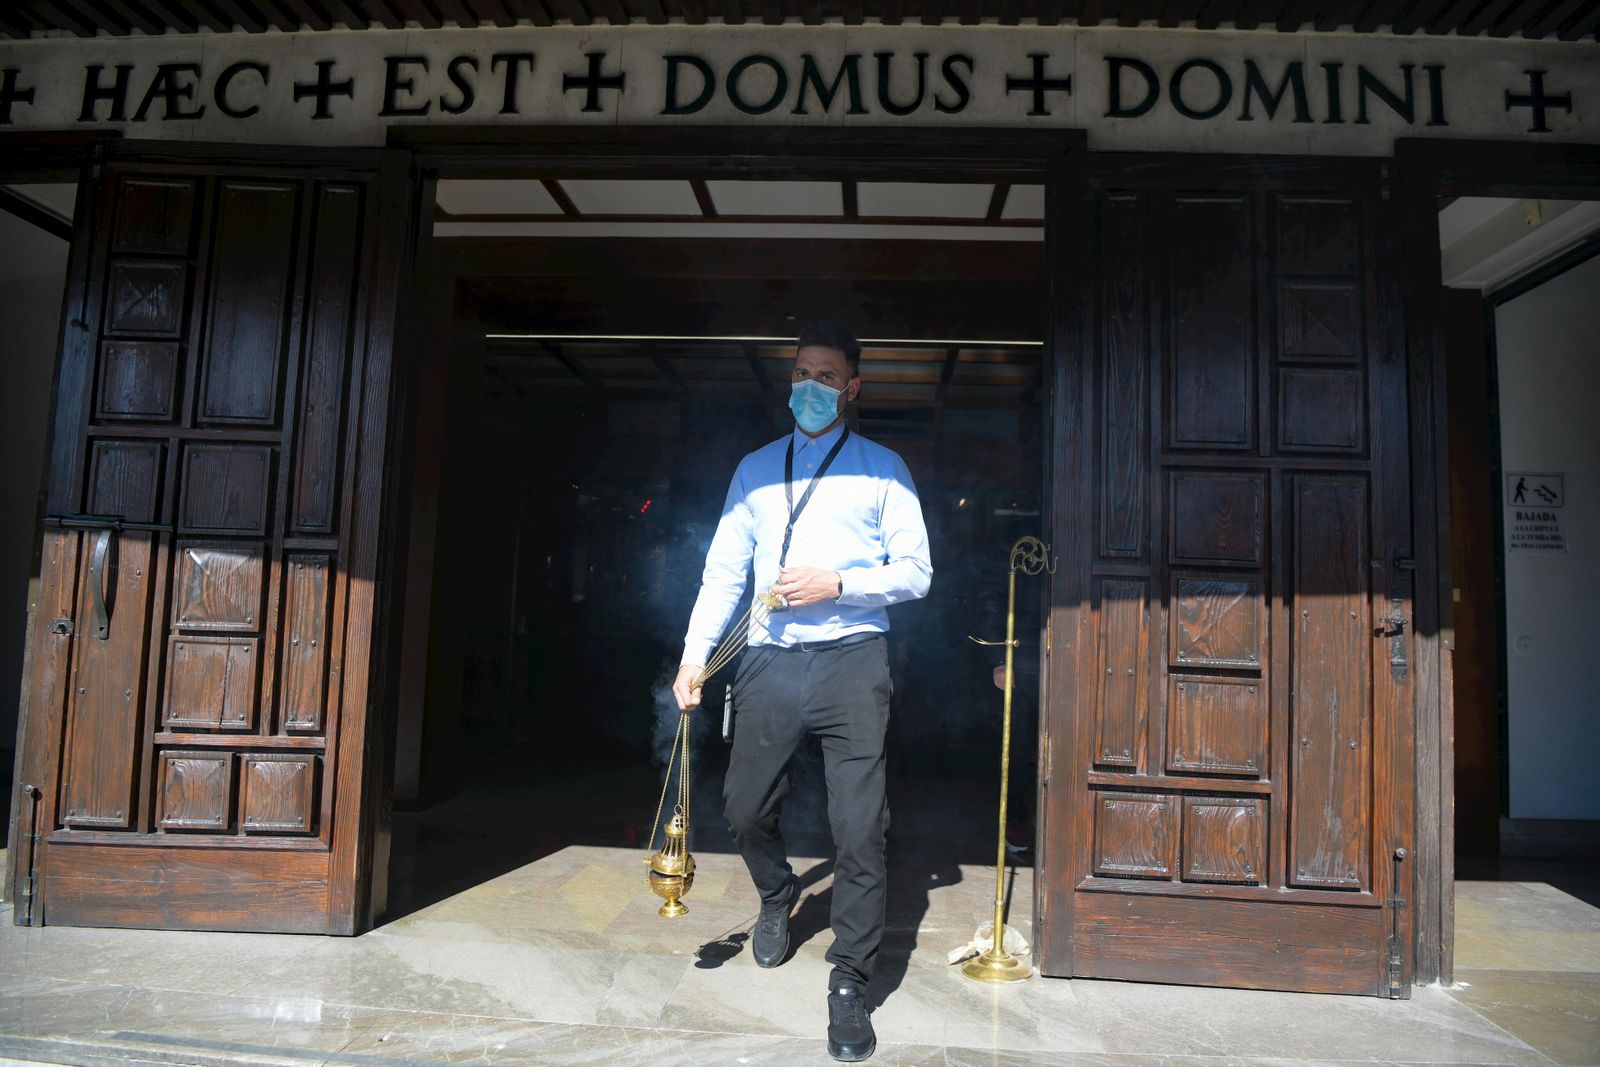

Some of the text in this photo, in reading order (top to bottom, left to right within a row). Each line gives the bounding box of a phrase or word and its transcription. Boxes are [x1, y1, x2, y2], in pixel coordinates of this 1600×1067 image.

[378, 53, 535, 117] EST
[659, 52, 974, 116] DOMUS
[1103, 56, 1449, 126] DOMINI
[1516, 511, 1557, 521] BAJADA
